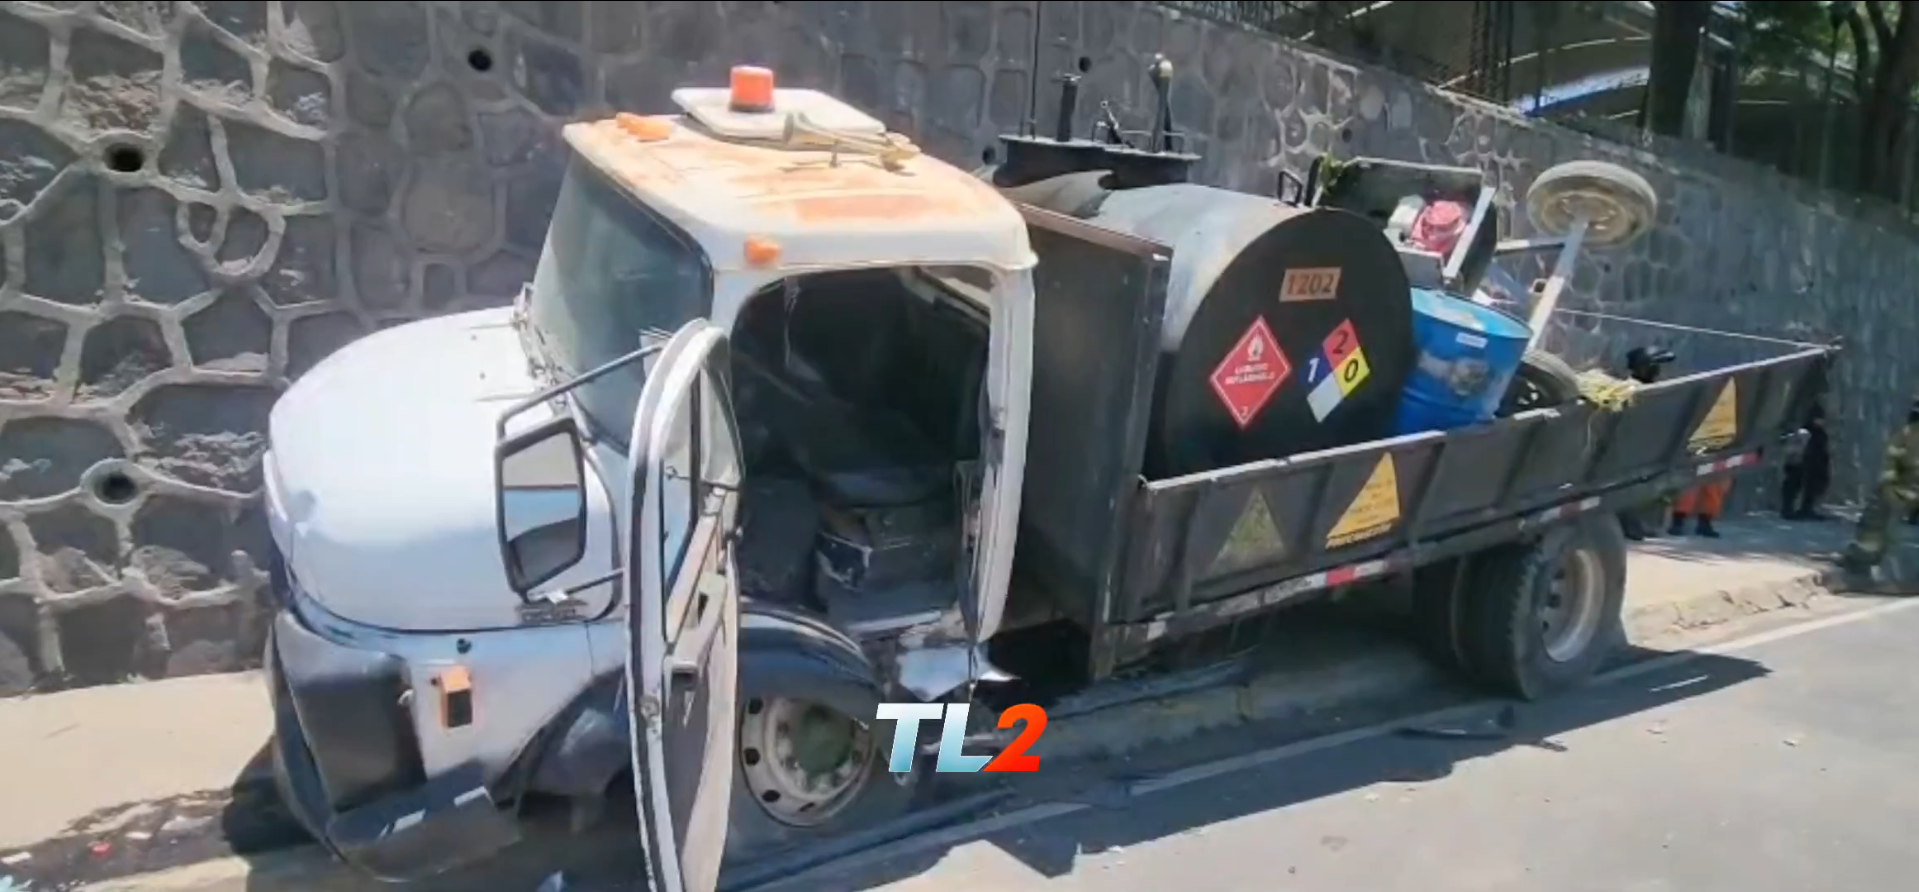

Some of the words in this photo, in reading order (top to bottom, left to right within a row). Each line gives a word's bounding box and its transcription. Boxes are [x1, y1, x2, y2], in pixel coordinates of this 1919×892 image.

[1286, 273, 1335, 296] 1202
[1332, 329, 1349, 354] 2
[1307, 357, 1320, 383] 1
[1343, 358, 1359, 383] 0
